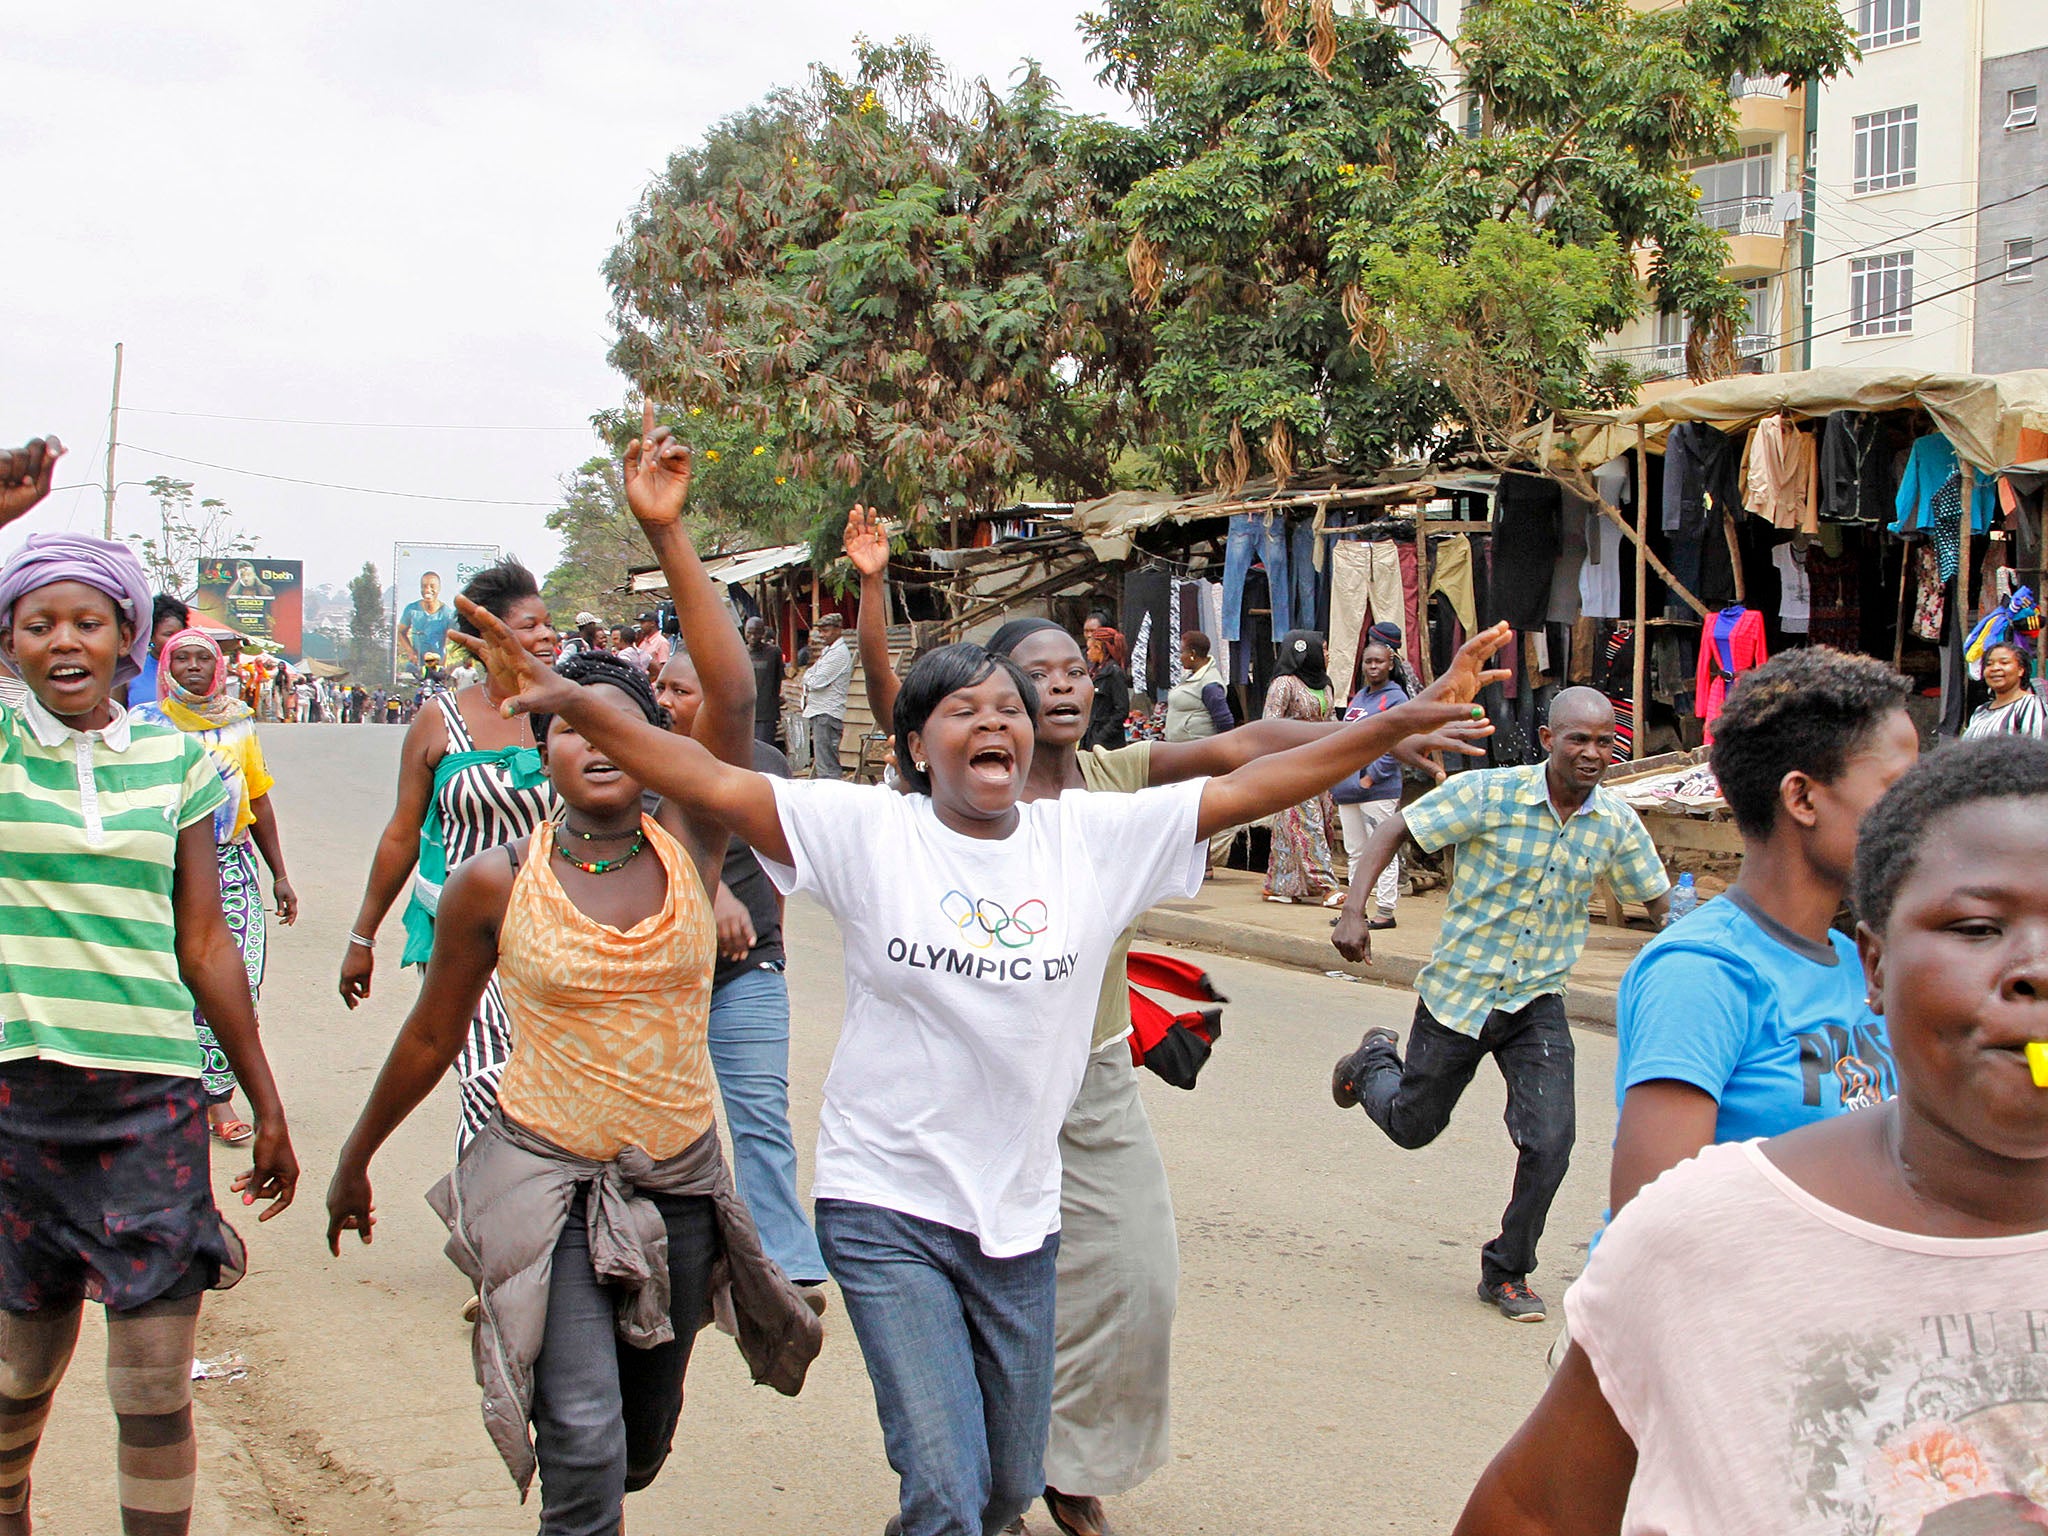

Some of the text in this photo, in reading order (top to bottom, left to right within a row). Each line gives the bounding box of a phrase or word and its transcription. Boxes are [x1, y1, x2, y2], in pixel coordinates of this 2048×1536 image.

[457, 562, 485, 573] Good
[887, 937, 1079, 981] OLYMPIC DAY
